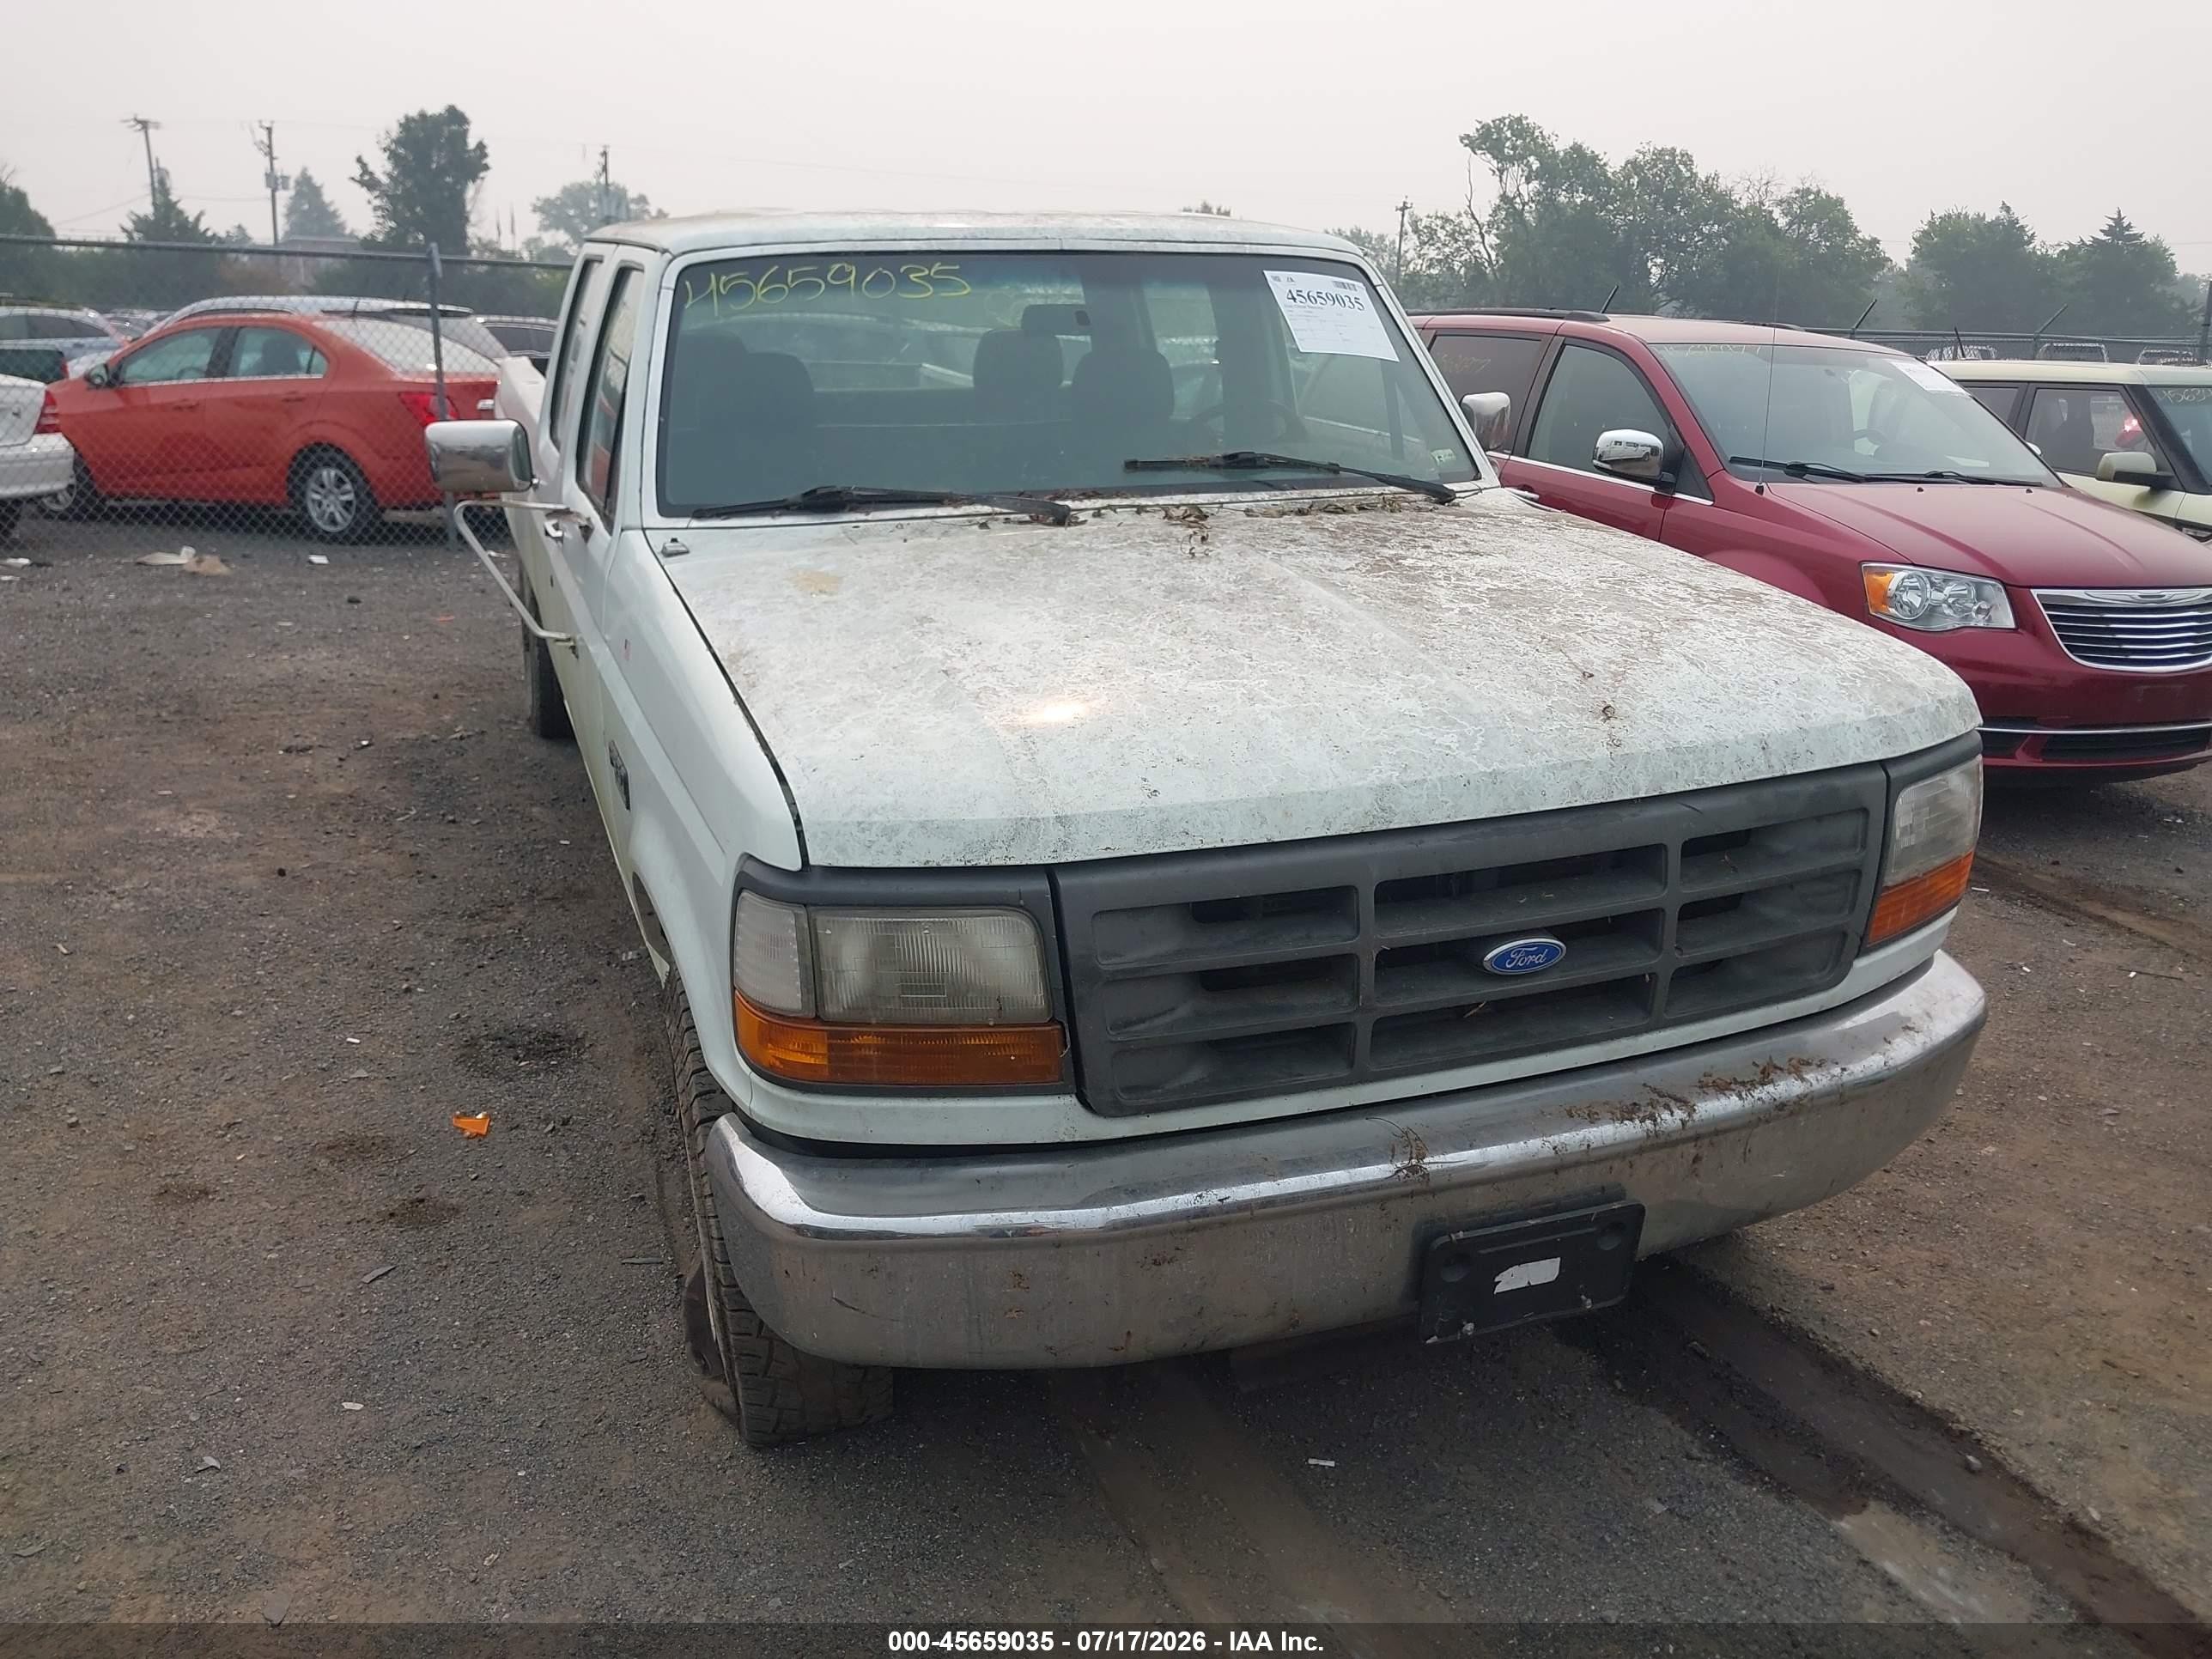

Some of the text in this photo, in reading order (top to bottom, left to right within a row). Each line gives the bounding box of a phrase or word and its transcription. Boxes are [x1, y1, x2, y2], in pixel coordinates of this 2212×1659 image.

[684, 261, 972, 316] 45659035
[1286, 289, 1365, 312] 45659035
[1505, 946, 1549, 969] Ford
